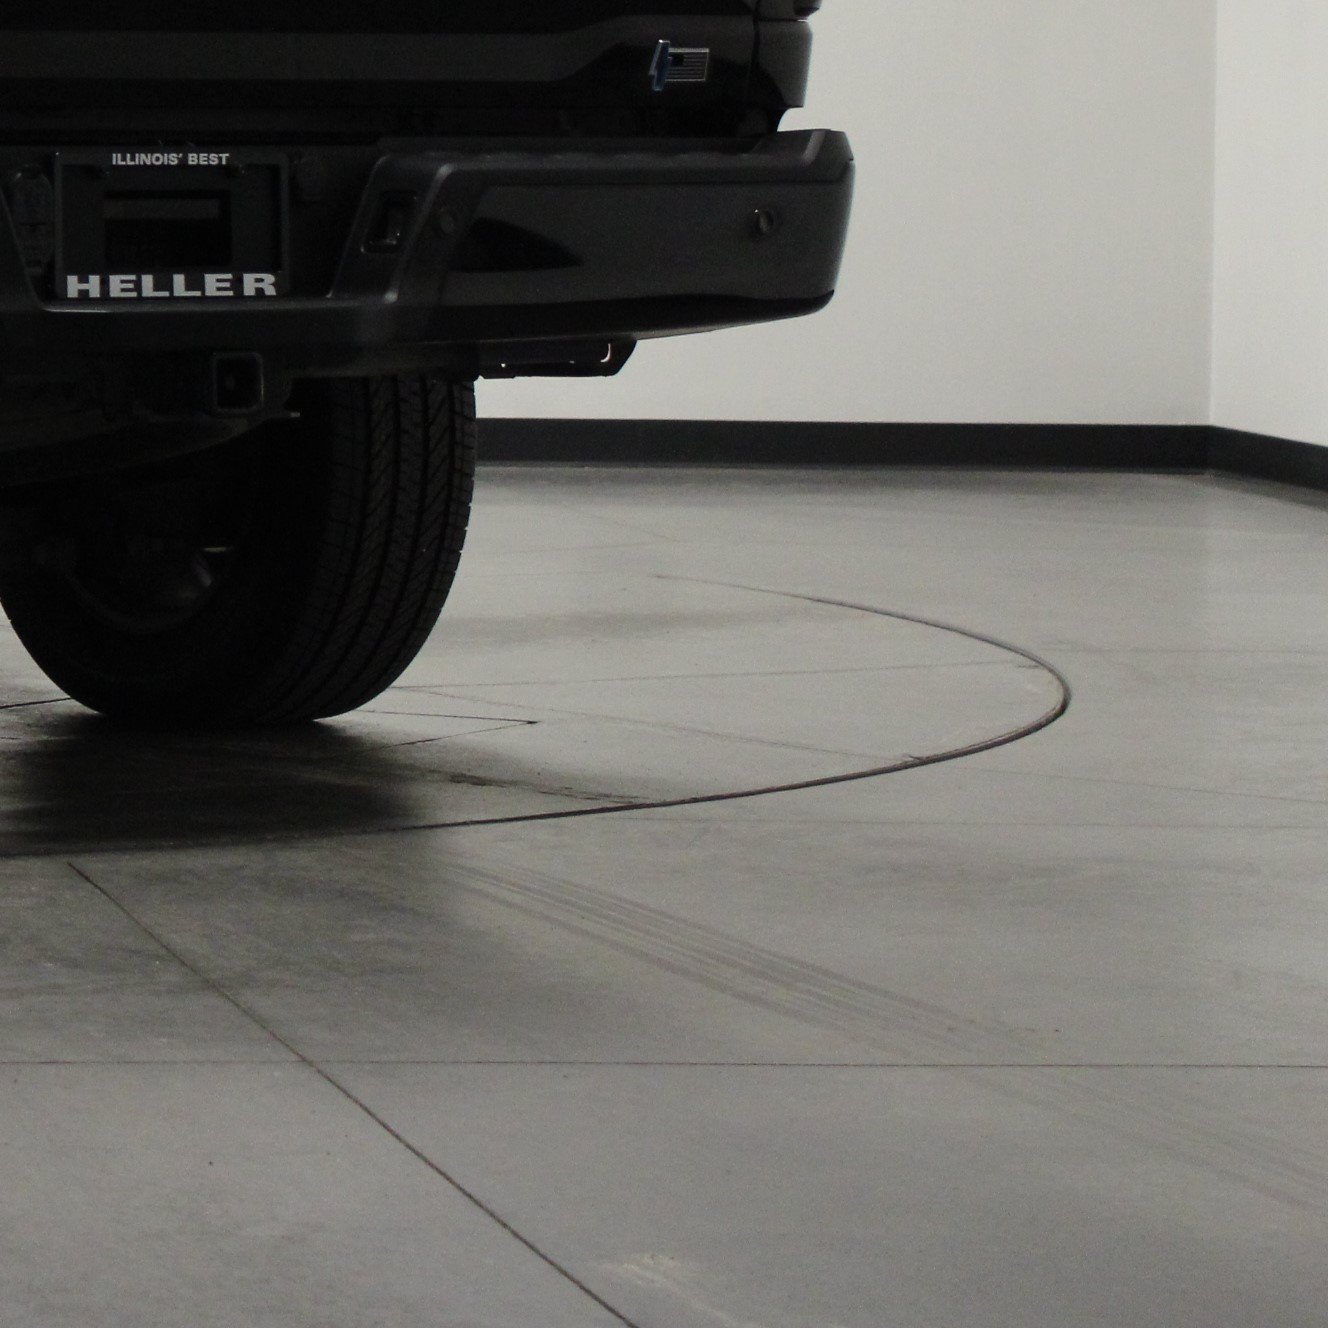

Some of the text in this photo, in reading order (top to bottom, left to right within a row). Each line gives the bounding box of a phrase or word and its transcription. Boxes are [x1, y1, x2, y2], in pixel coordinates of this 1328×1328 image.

[112, 152, 230, 166] ILLINOIS' BEST
[66, 273, 277, 299] HELLER
